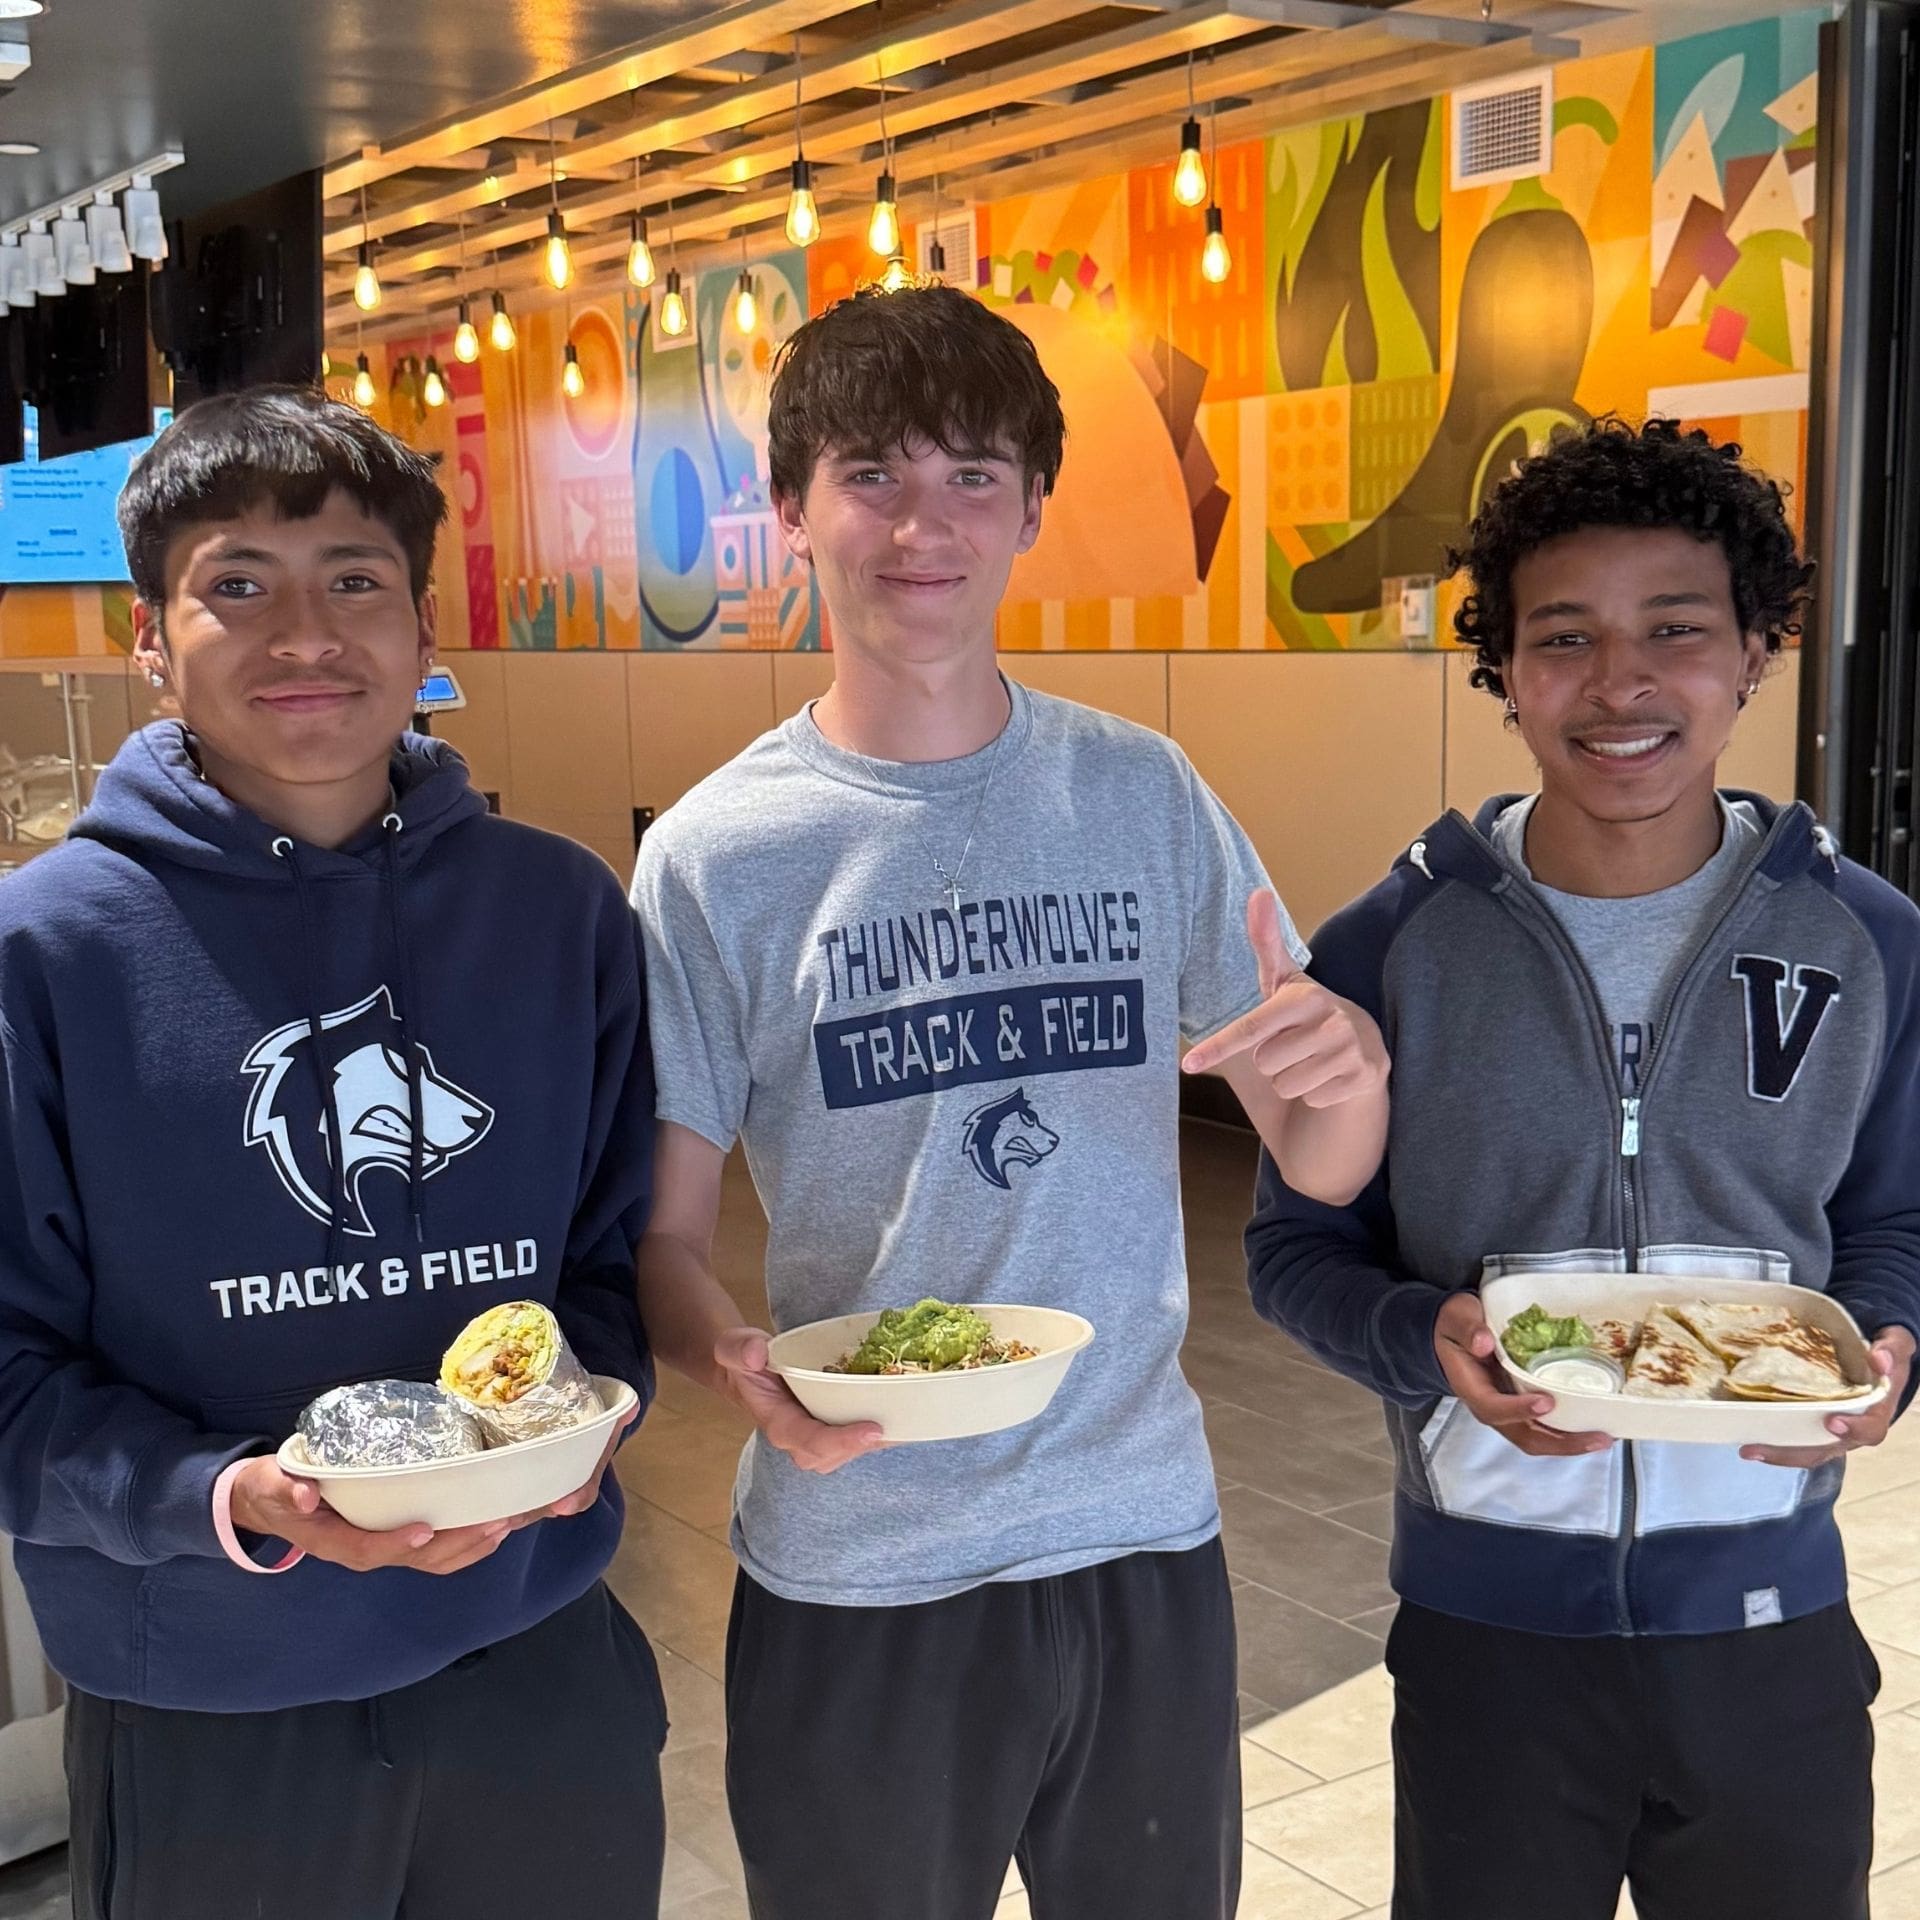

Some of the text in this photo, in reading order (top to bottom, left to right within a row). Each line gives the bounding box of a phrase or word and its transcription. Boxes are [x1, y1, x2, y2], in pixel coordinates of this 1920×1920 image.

[817, 891, 1140, 1002] THUNDERWOLVES
[840, 994, 1129, 1089] TRACK & FIELD
[1730, 953, 1841, 1102] V
[210, 1238, 537, 1318] TRACK & FIELD
